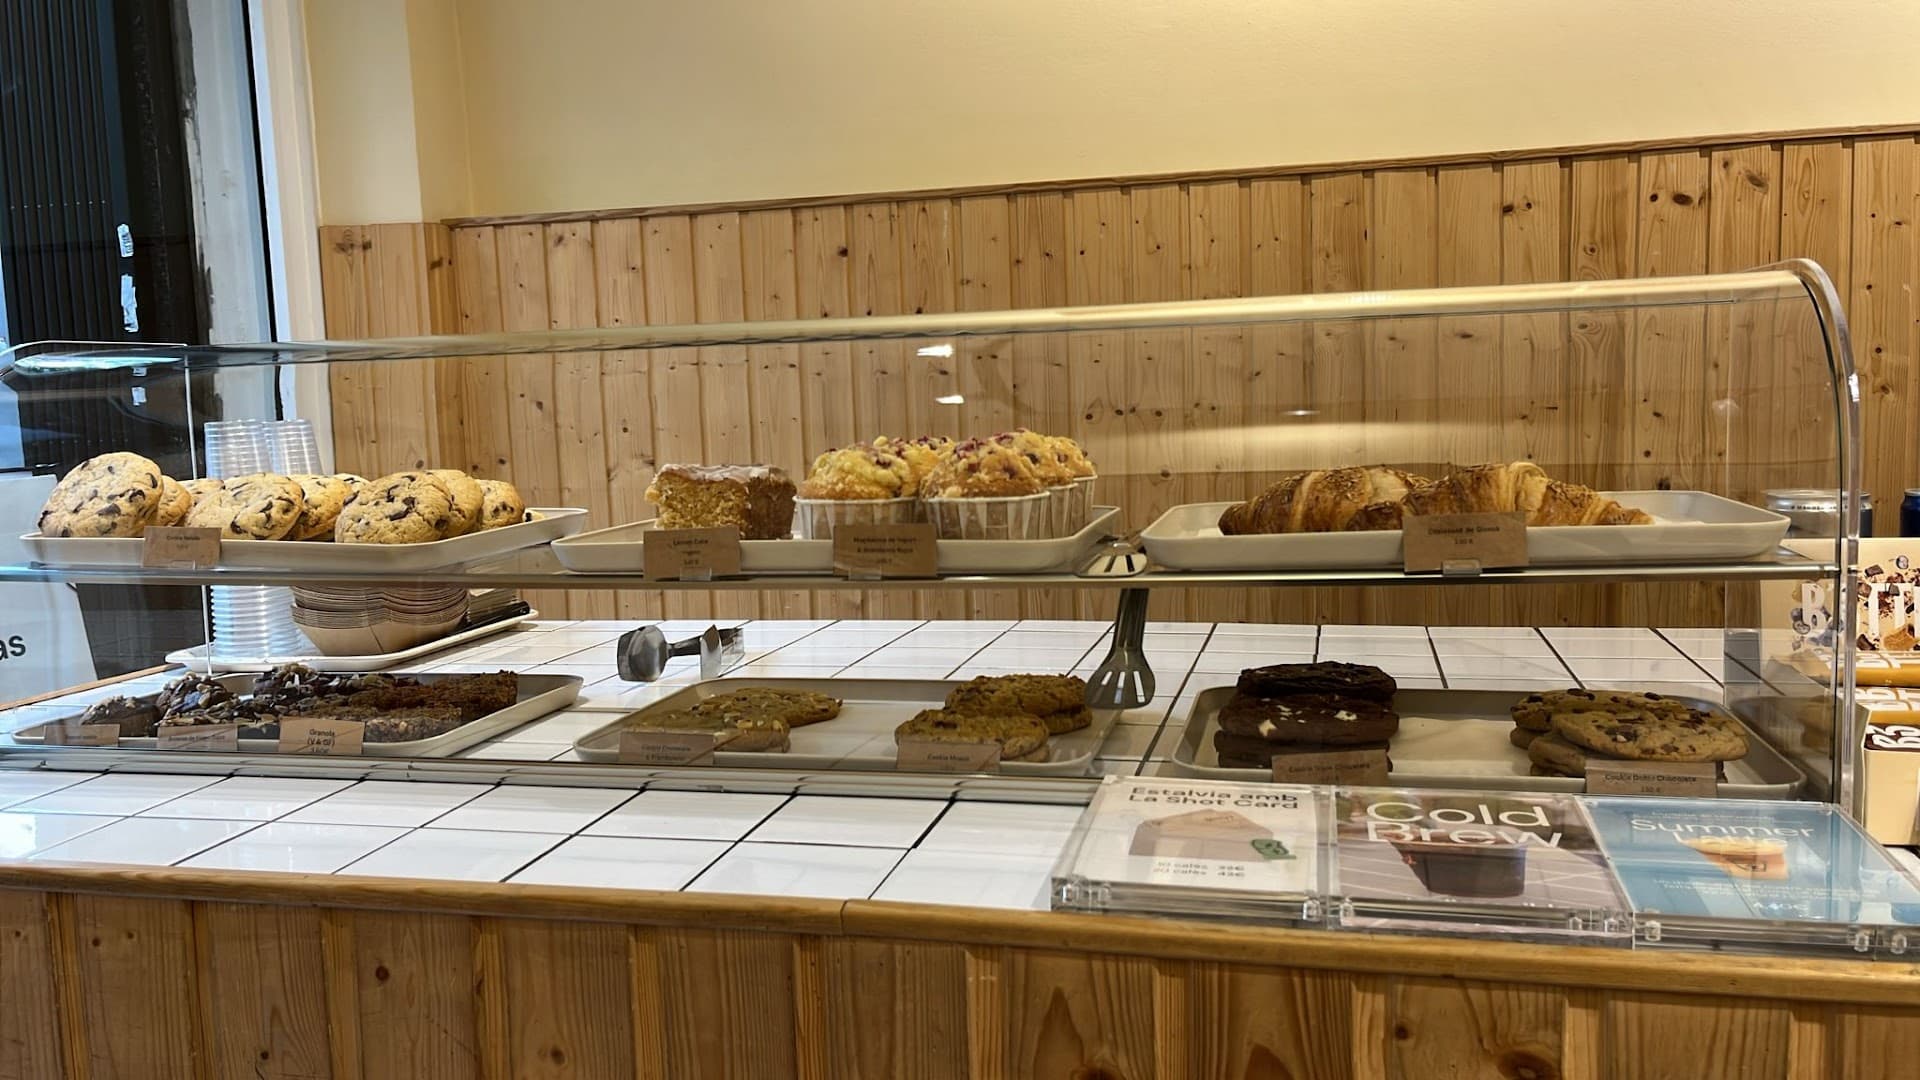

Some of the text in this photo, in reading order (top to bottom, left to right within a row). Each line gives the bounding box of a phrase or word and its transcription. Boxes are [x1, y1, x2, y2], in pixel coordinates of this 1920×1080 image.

[1129, 795, 1298, 809] La Shot Card
[1132, 787, 1298, 802] Estalvia amb
[1366, 801, 1551, 828] Cold
[1367, 820, 1563, 849] Brew
[1630, 818, 1815, 838] Summer
